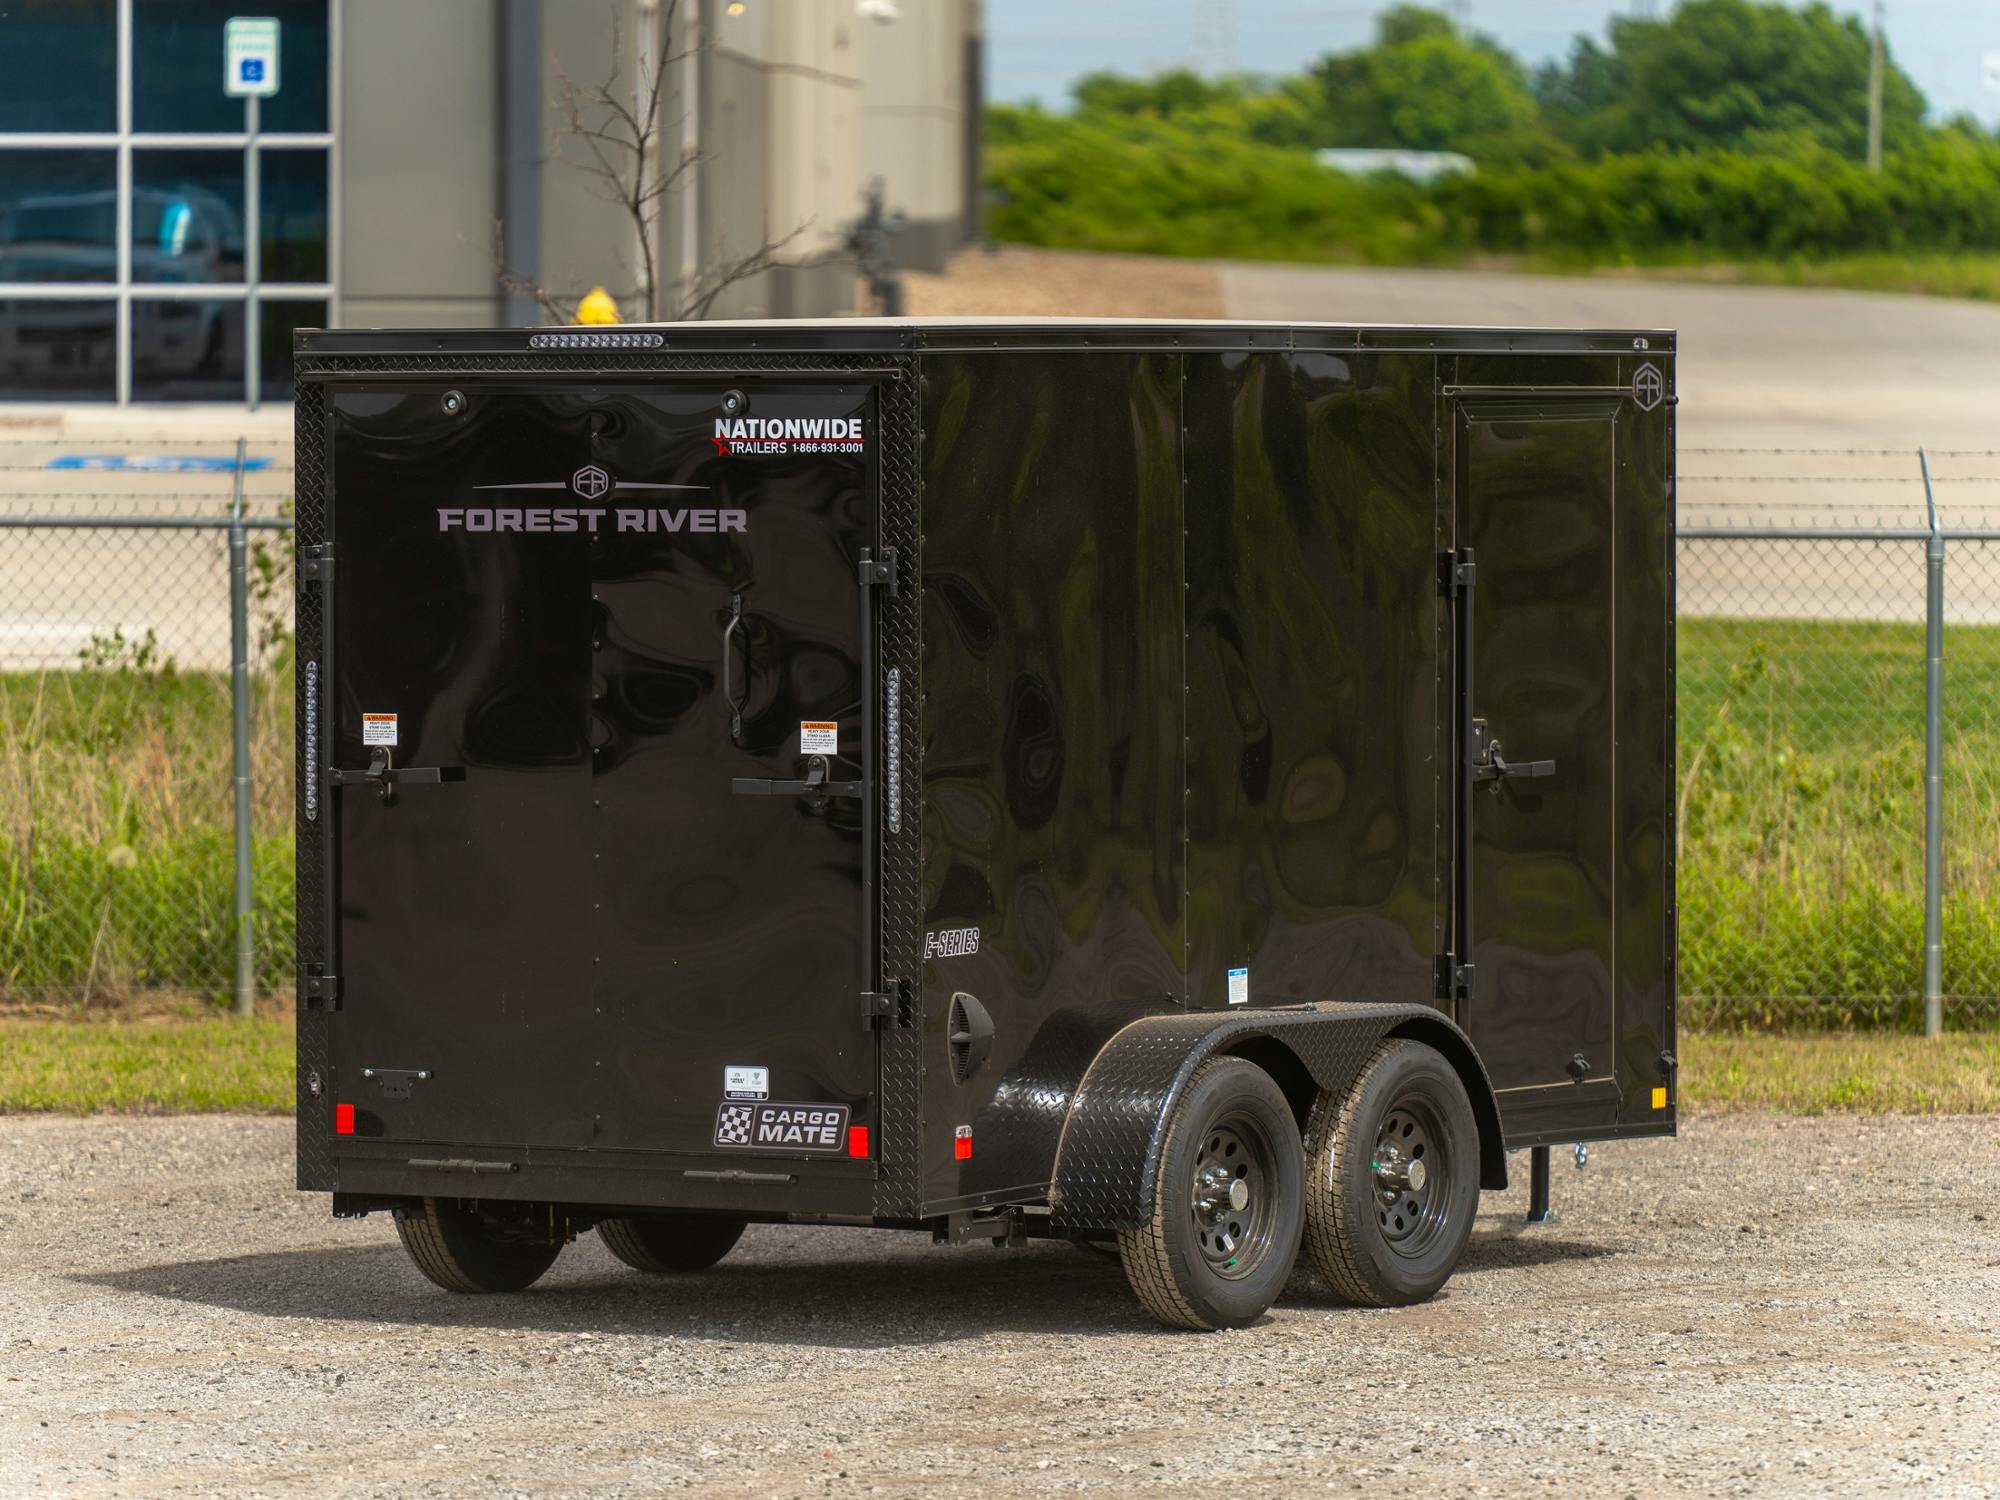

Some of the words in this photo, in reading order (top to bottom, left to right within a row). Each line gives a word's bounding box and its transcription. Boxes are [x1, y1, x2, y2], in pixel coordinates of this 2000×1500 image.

[715, 418, 862, 439] NATIONWIDE
[729, 441, 787, 454] TRAILERS
[793, 442, 863, 453] 1-866-931-3001
[437, 509, 605, 531] FOREST
[617, 509, 747, 532] RIVER
[924, 927, 980, 959] E-SERIES
[761, 1110, 840, 1125] CARGO
[758, 1124, 838, 1144] MATE
